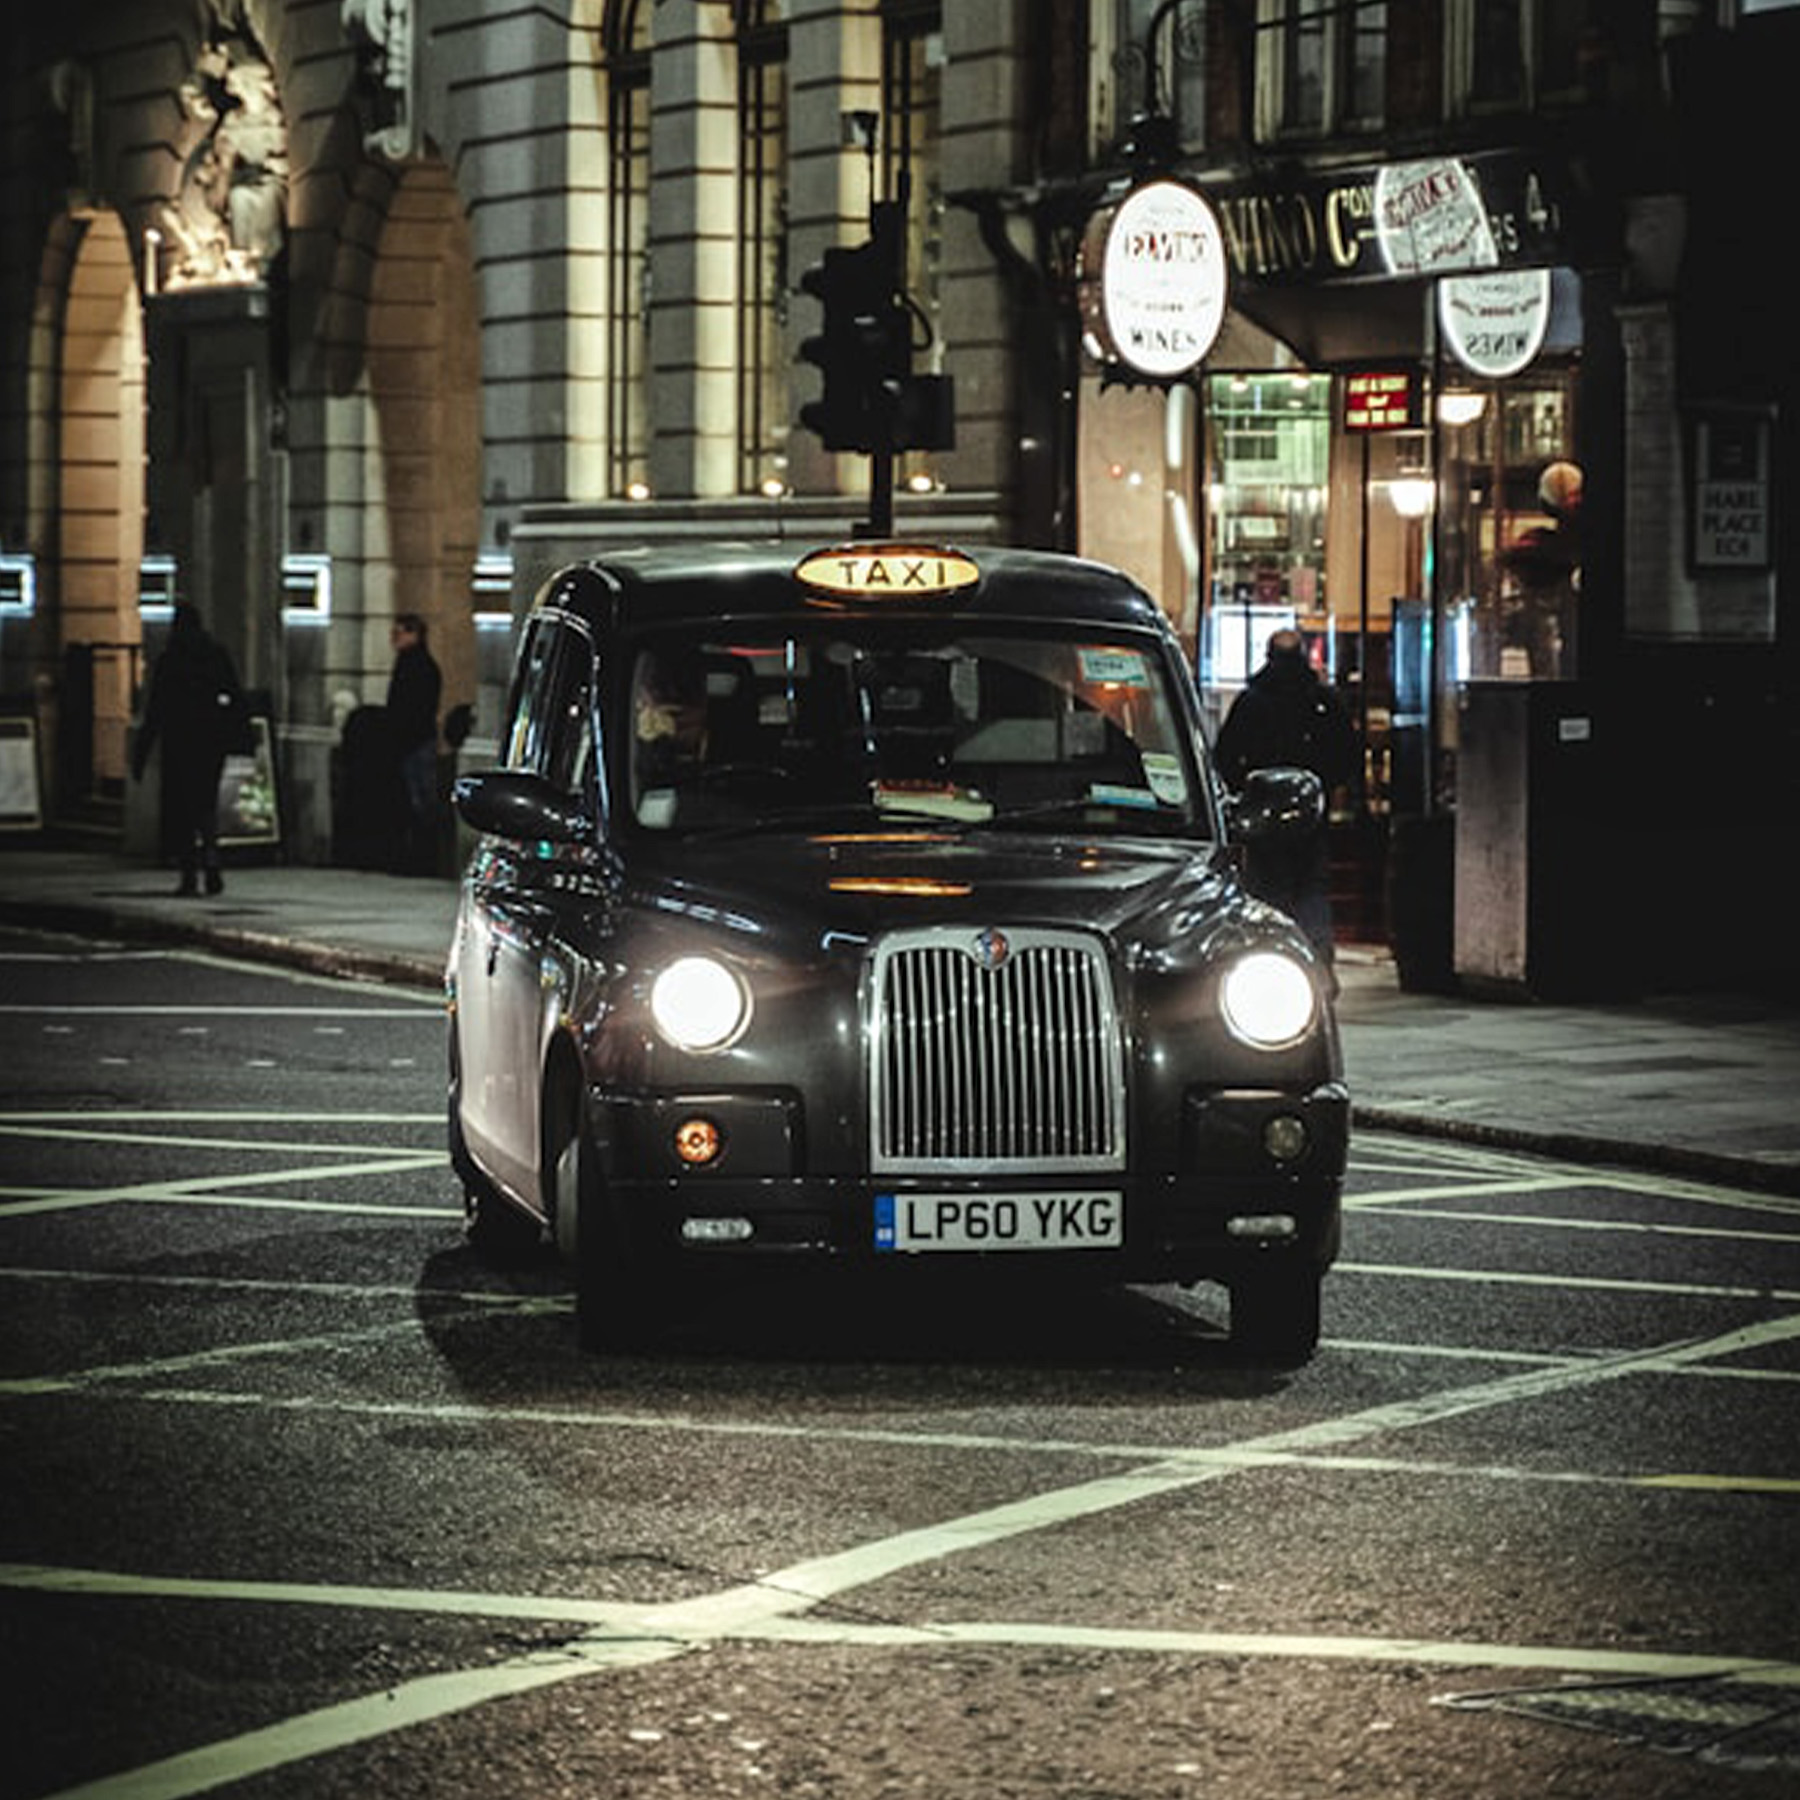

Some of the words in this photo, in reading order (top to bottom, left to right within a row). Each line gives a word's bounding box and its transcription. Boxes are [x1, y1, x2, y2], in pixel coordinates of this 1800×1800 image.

[1219, 193, 1318, 275] VINO
[1130, 327, 1199, 353] WINES
[1702, 513, 1763, 534] PLACE
[1715, 537, 1750, 557] EC4
[838, 560, 946, 586] TAXI
[907, 1201, 1018, 1240] LP60
[1033, 1198, 1116, 1238] YKG
